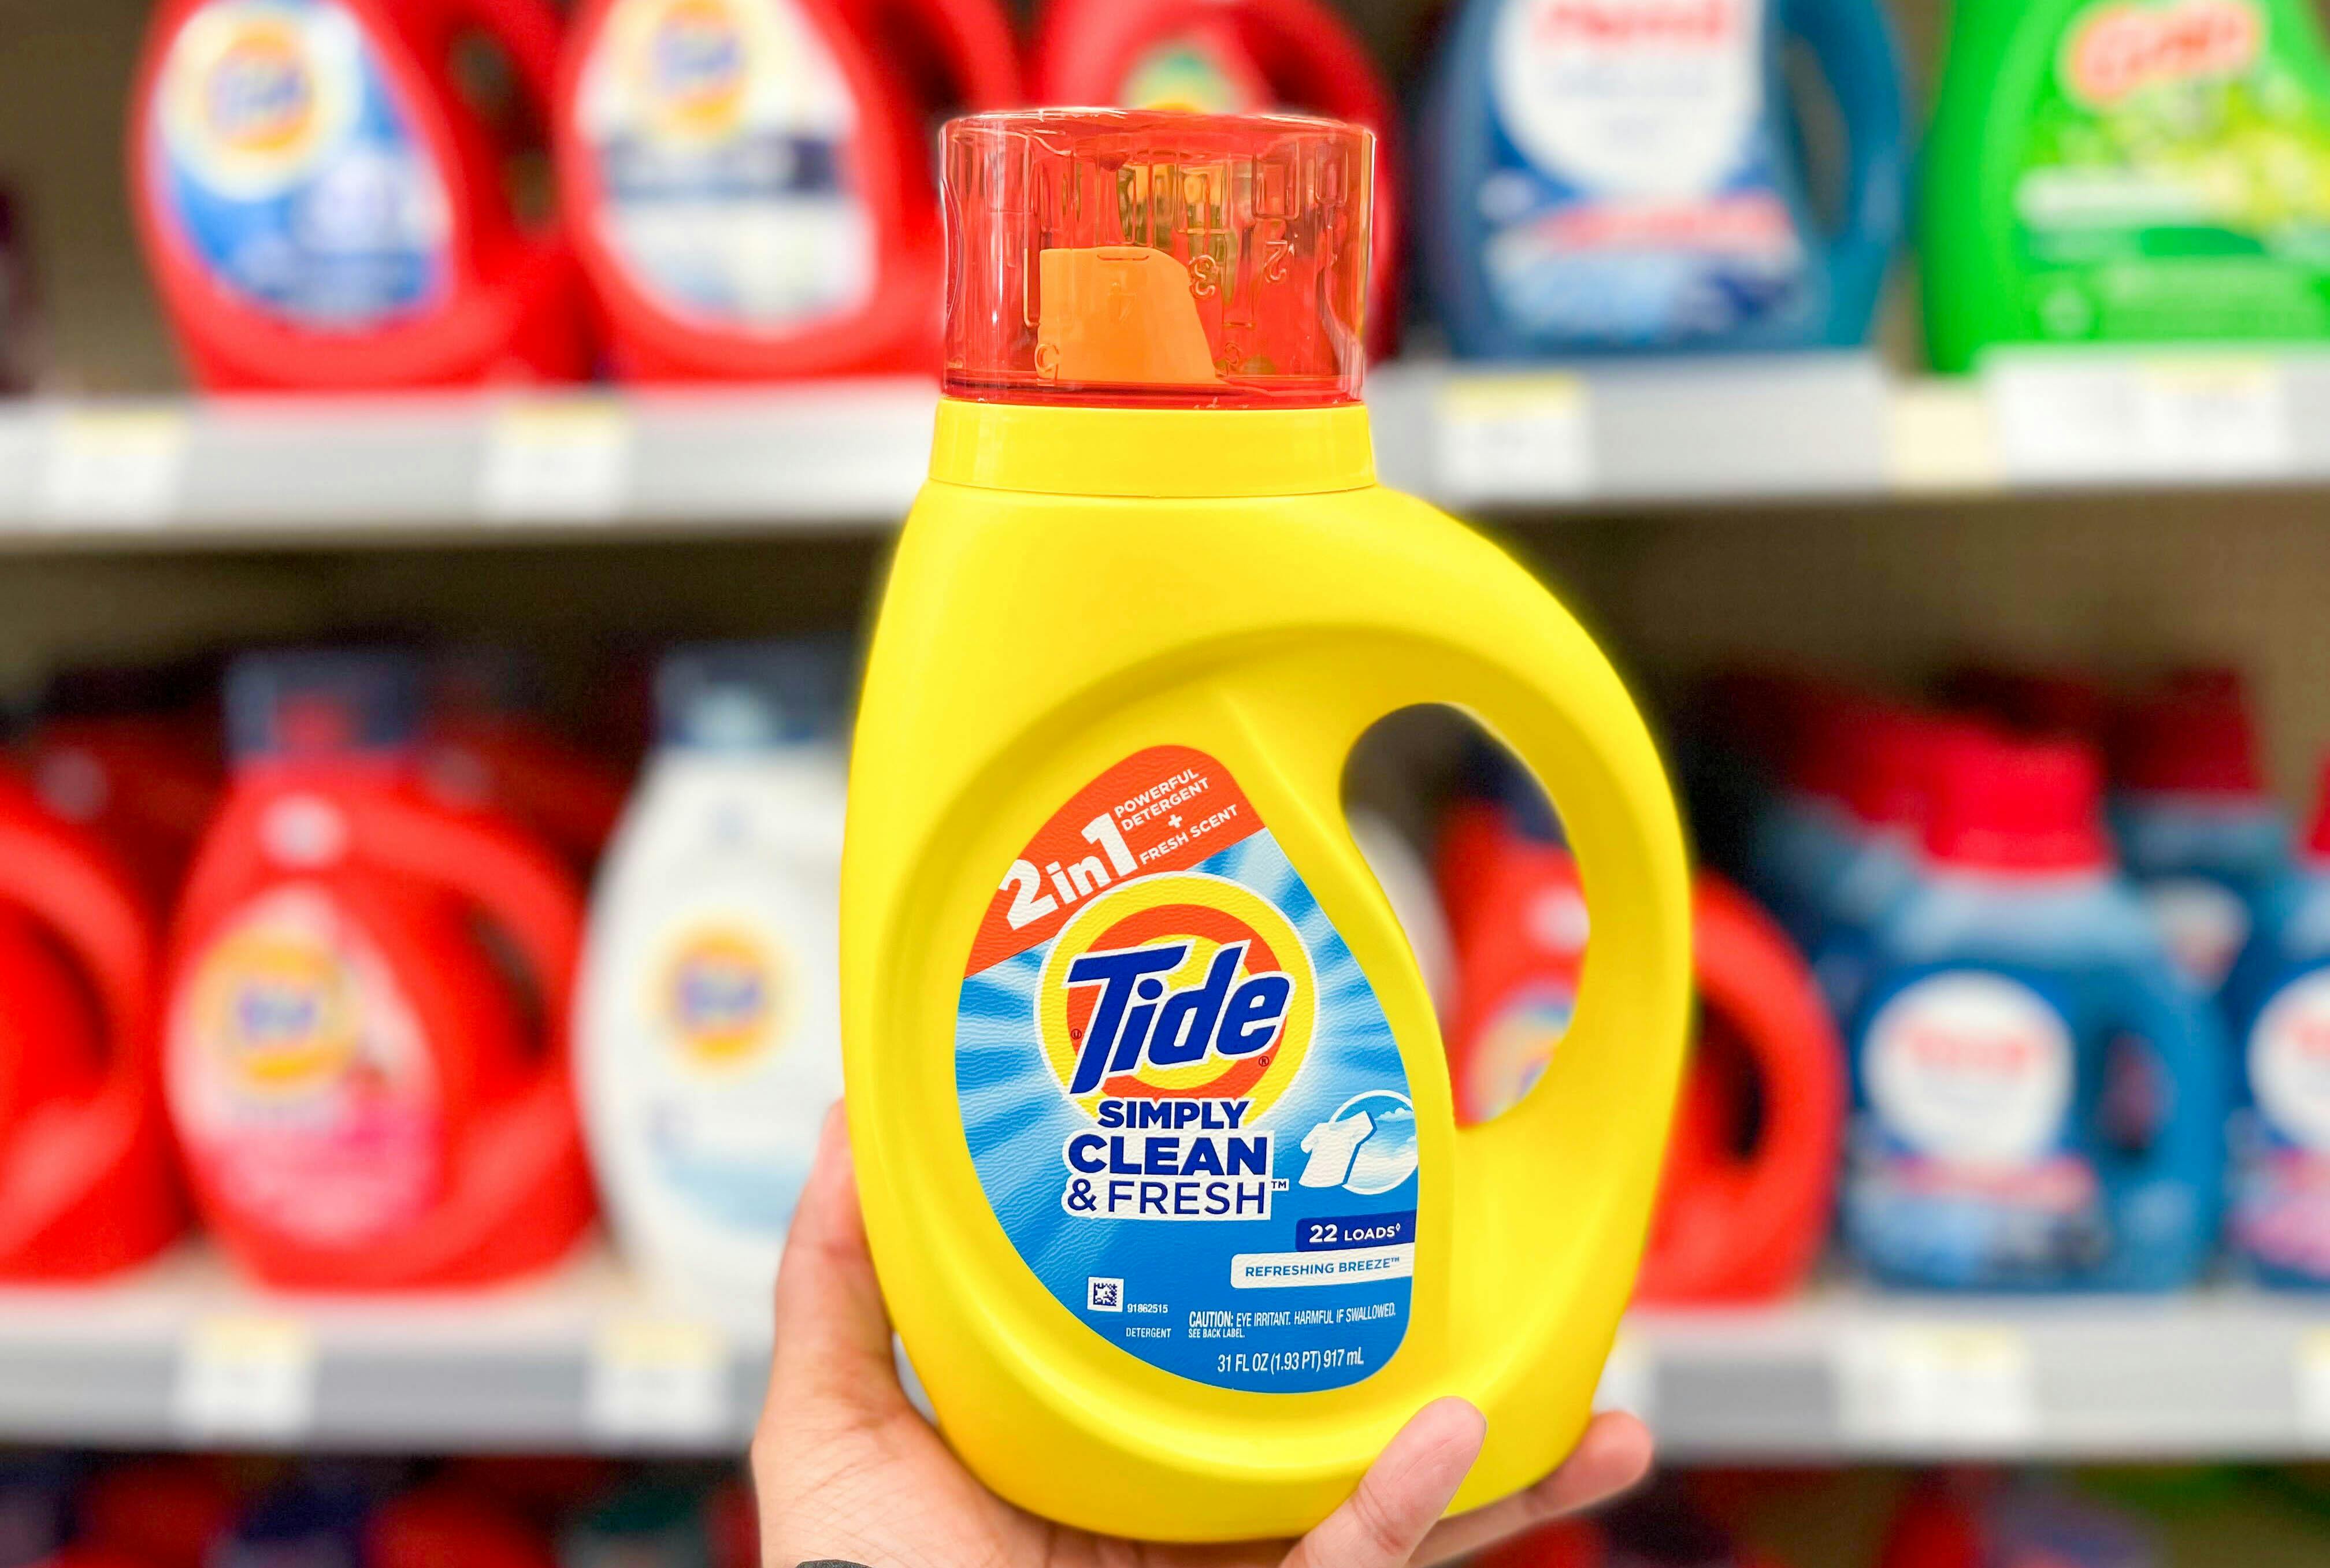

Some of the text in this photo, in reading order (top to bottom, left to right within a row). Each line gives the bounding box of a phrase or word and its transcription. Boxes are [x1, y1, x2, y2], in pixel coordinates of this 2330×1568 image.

[1114, 768, 1200, 818] POWERFUL
[1121, 777, 1209, 831] DETERGENT
[1139, 804, 1238, 865] FRESH SCENT
[1068, 945, 1290, 1094] Tide
[1097, 1100, 1249, 1129] SIMPLY
[1068, 1134, 1267, 1176] CLEAN
[1067, 1178, 1097, 1212] &
[1309, 1224, 1338, 1243] 22
[1245, 1263, 1334, 1277] REFRESHING
[1127, 1303, 1168, 1313] 91862515
[1189, 1302, 1396, 1328] CAUTION: EYE IRRITANT. HARMFUL IF SWALLOWED.
[1126, 1327, 1171, 1338] DETERGENT
[1188, 1328, 1245, 1339] SEE BACK LABEL.
[1217, 1346, 1364, 1374] 31 FL OZ (1.93 PT) 917 mL
